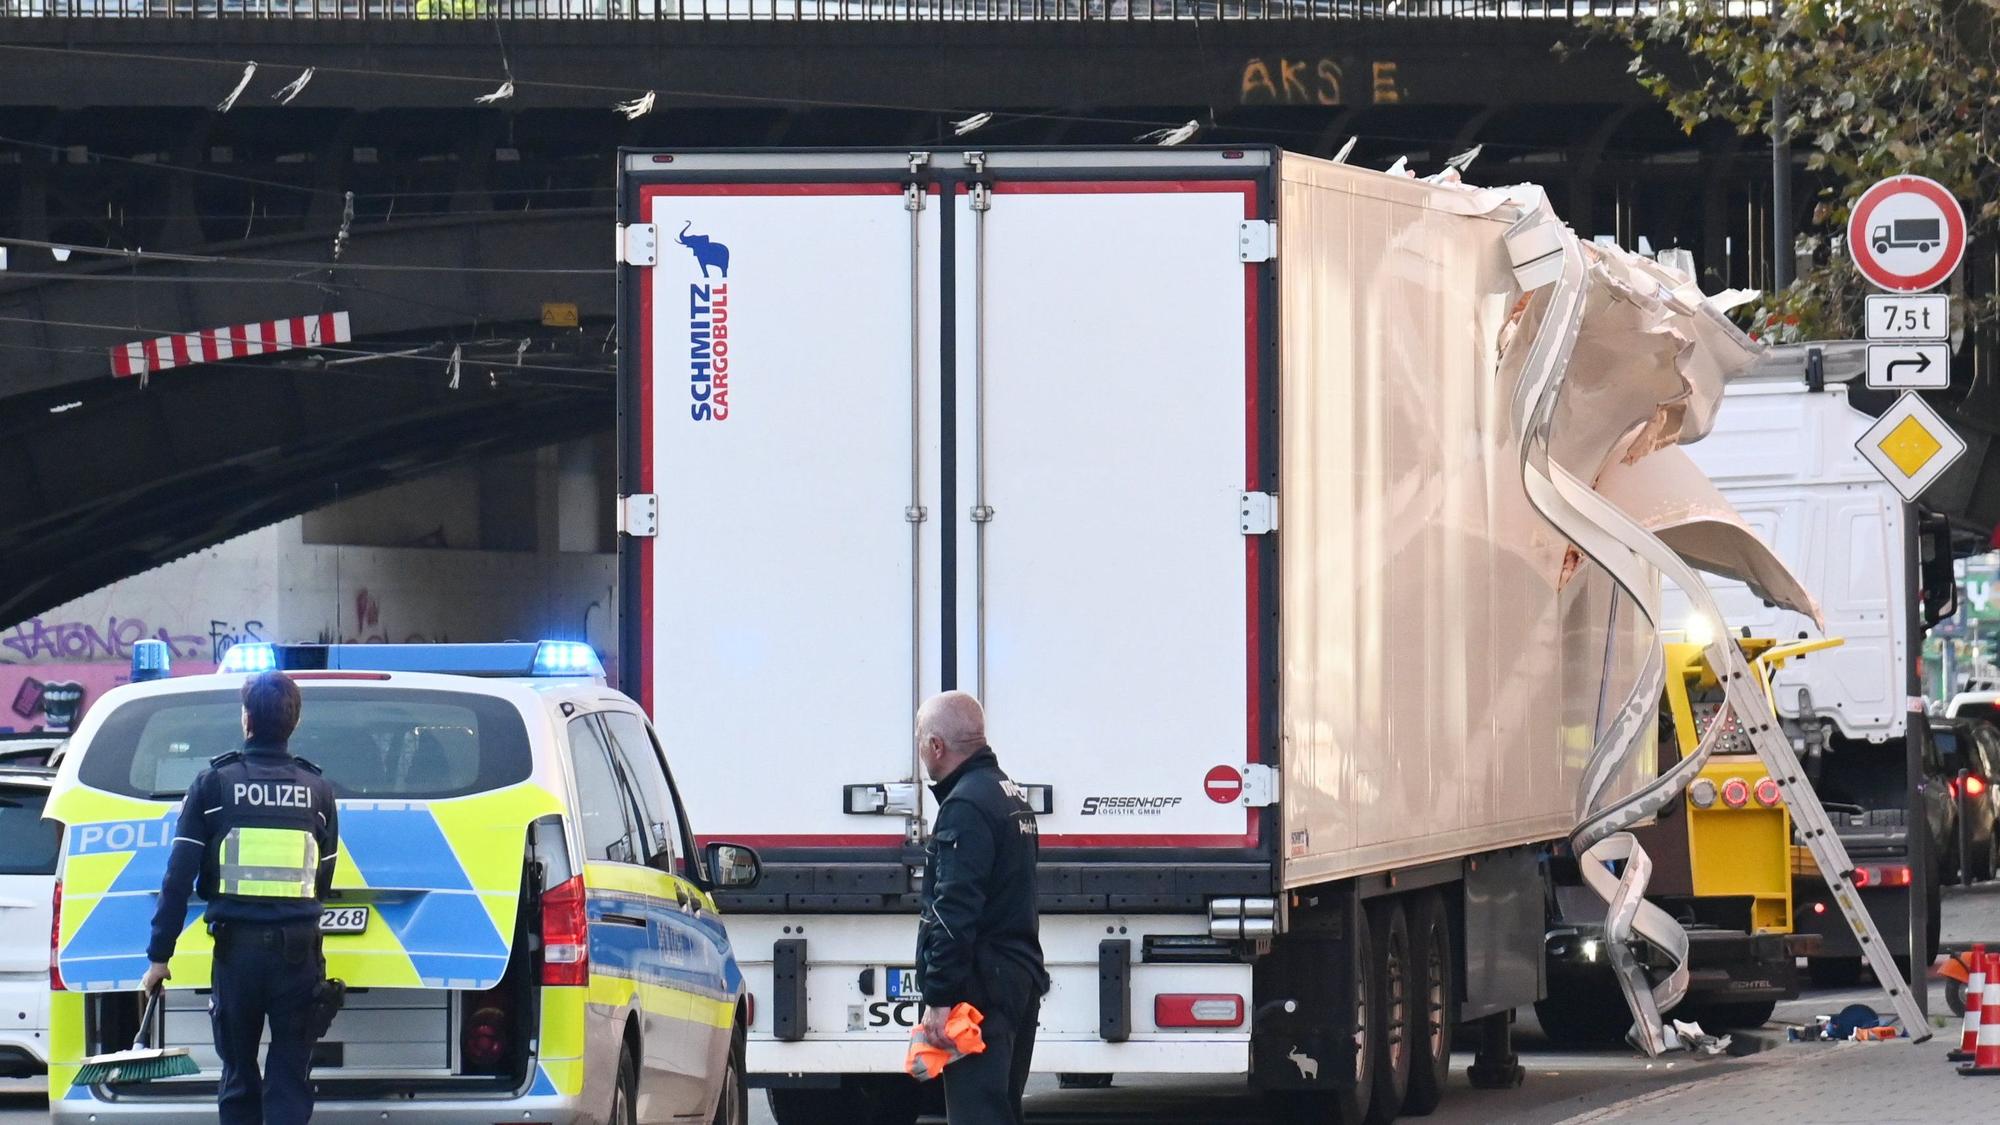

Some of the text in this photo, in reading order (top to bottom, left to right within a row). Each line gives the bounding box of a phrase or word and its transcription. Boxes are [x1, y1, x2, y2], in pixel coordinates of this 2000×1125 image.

[690, 283, 711, 421] SCHMITZ
[712, 283, 728, 421] CARGOBULL
[234, 783, 311, 808] POLIZEI
[1081, 797, 1182, 815] SASSENHOFF
[79, 821, 175, 852] POLI
[321, 910, 364, 927] 268
[868, 1002, 925, 1027] SC
